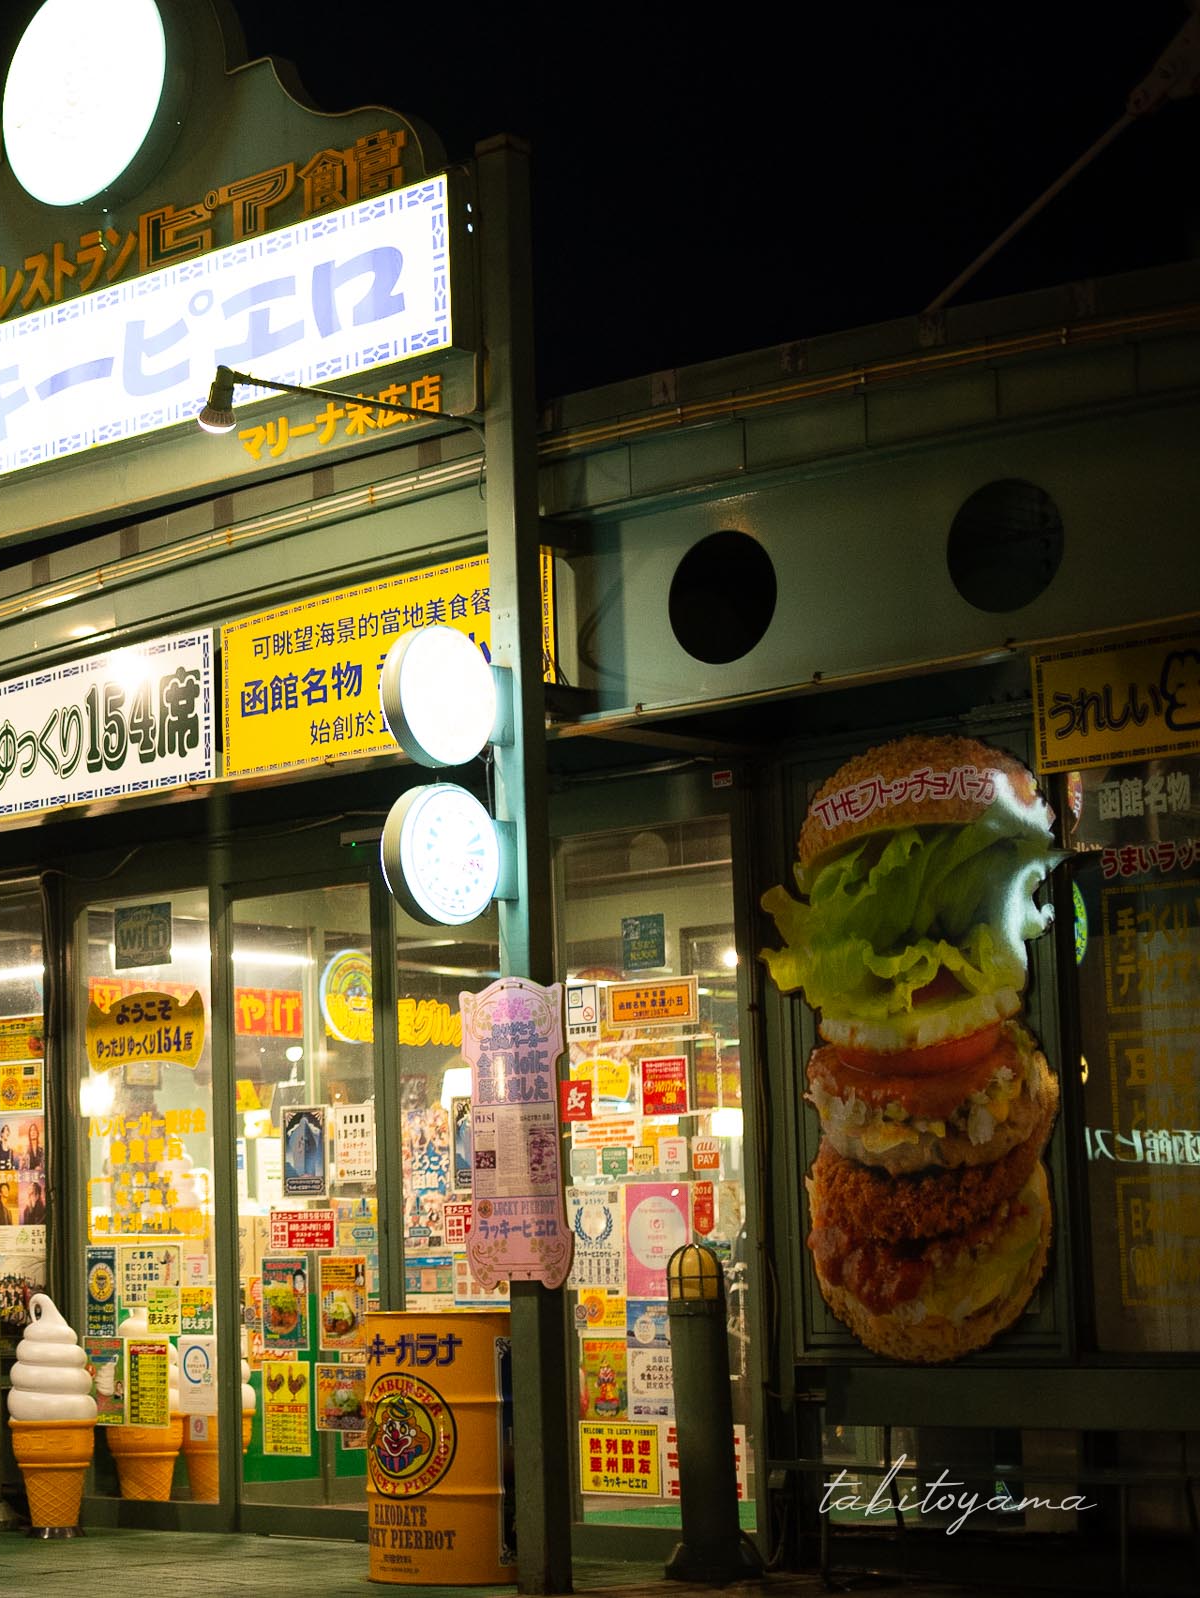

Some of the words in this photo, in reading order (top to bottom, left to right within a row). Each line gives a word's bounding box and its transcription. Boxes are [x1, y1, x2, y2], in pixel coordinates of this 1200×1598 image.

[238, 374, 443, 460] マリーナ末広店
[252, 587, 491, 660] 可眺望海景的當地美食餐
[240, 660, 363, 718] 函館名物
[814, 767, 998, 828] THEフトッチョバーガ
[1099, 772, 1191, 820] 函館名物
[116, 999, 173, 1025] ようこそ
[96, 1026, 194, 1059] ゆったりゆっくり154席
[696, 1141, 715, 1151] au
[697, 1154, 715, 1165] PAY
[479, 1219, 559, 1240] ラッキーピエロ
[148, 1314, 179, 1325] 使えます
[182, 1318, 213, 1329] 使えます
[370, 1378, 443, 1418] AMBURGER
[583, 1427, 604, 1435] WELCOME
[616, 1428, 631, 1436] LUCKY
[634, 1428, 657, 1437] PIERROT
[404, 1433, 451, 1494] PIERROT
[603, 1475, 648, 1489] ラッキーピエロ
[374, 1503, 427, 1527] HAKODATE
[390, 1529, 457, 1550] PIERROT
